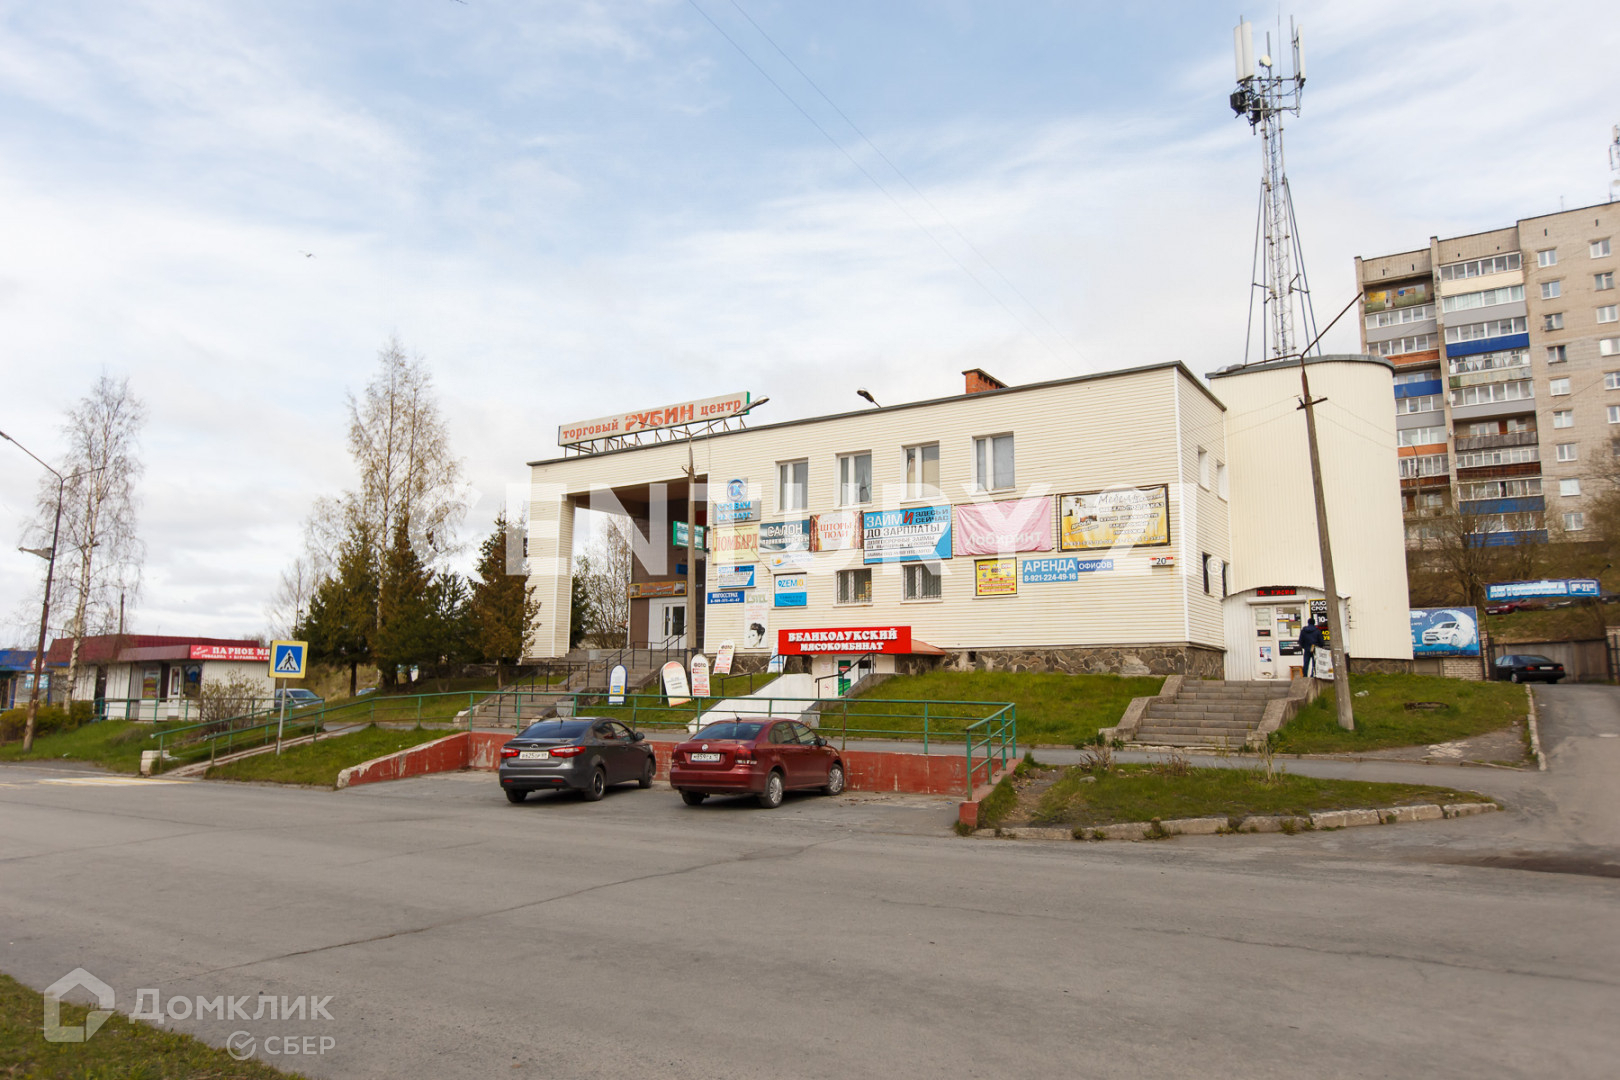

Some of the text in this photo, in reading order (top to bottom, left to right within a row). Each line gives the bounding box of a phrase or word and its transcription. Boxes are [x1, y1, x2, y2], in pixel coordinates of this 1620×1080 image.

[563, 400, 741, 439] торговый РУБИН центр
[768, 524, 802, 536] САЛОН
[820, 522, 852, 532] ШТОРЫ
[866, 524, 940, 538] ДО ЗАРПЛАТЫ
[714, 534, 758, 552] ЛОМБАРД
[1024, 559, 1076, 572] АРЕНДА
[1024, 573, 1076, 582] 8-921-224-49-16
[788, 628, 898, 642] ВЕЛИКОЛУКСКИЙ
[212, 646, 254, 655] ПАРНОЕ
[800, 642, 884, 651] МЯСОКОМБИНАТ
